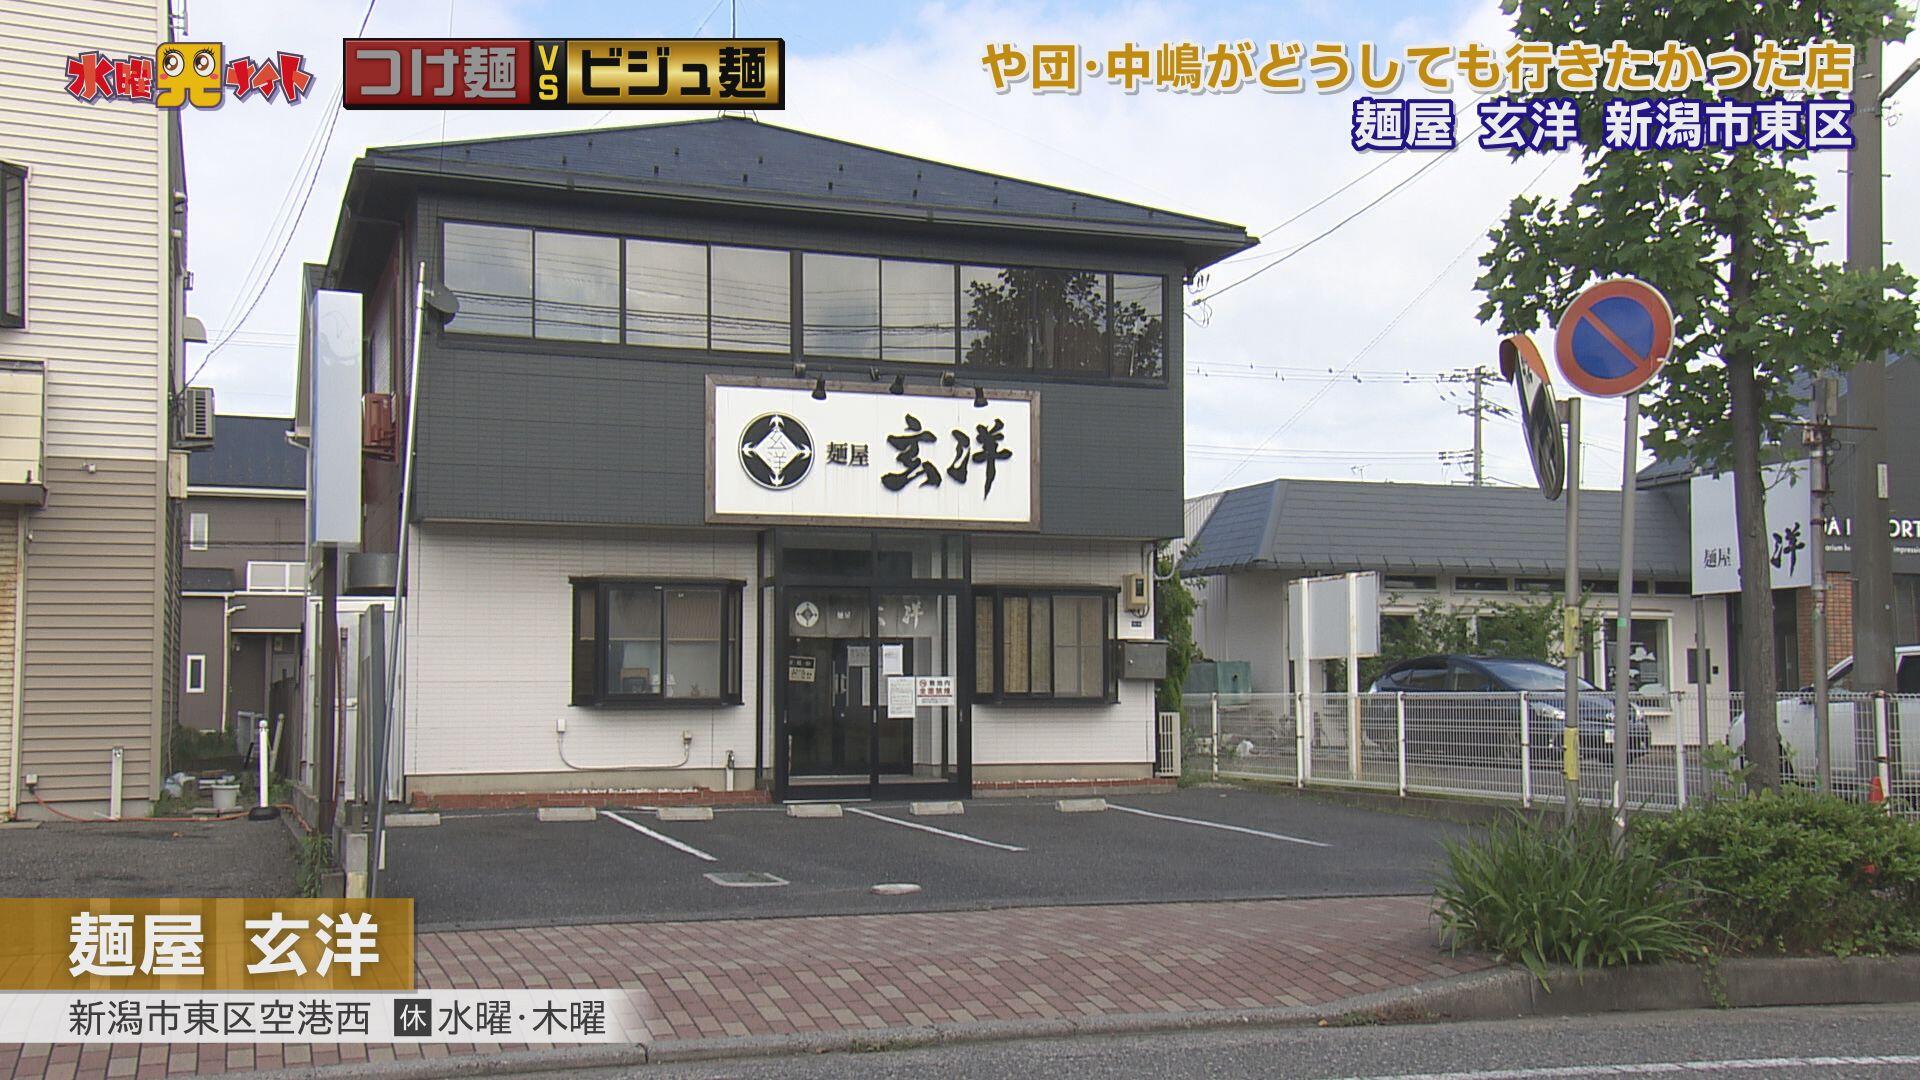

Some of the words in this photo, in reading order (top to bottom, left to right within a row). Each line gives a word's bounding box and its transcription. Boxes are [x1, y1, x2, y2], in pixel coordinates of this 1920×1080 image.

[825, 440, 870, 467] 麺屋
[880, 413, 1013, 501] 玄洋
[1703, 547, 1731, 569] 麺屋
[1770, 522, 1806, 577] 洋
